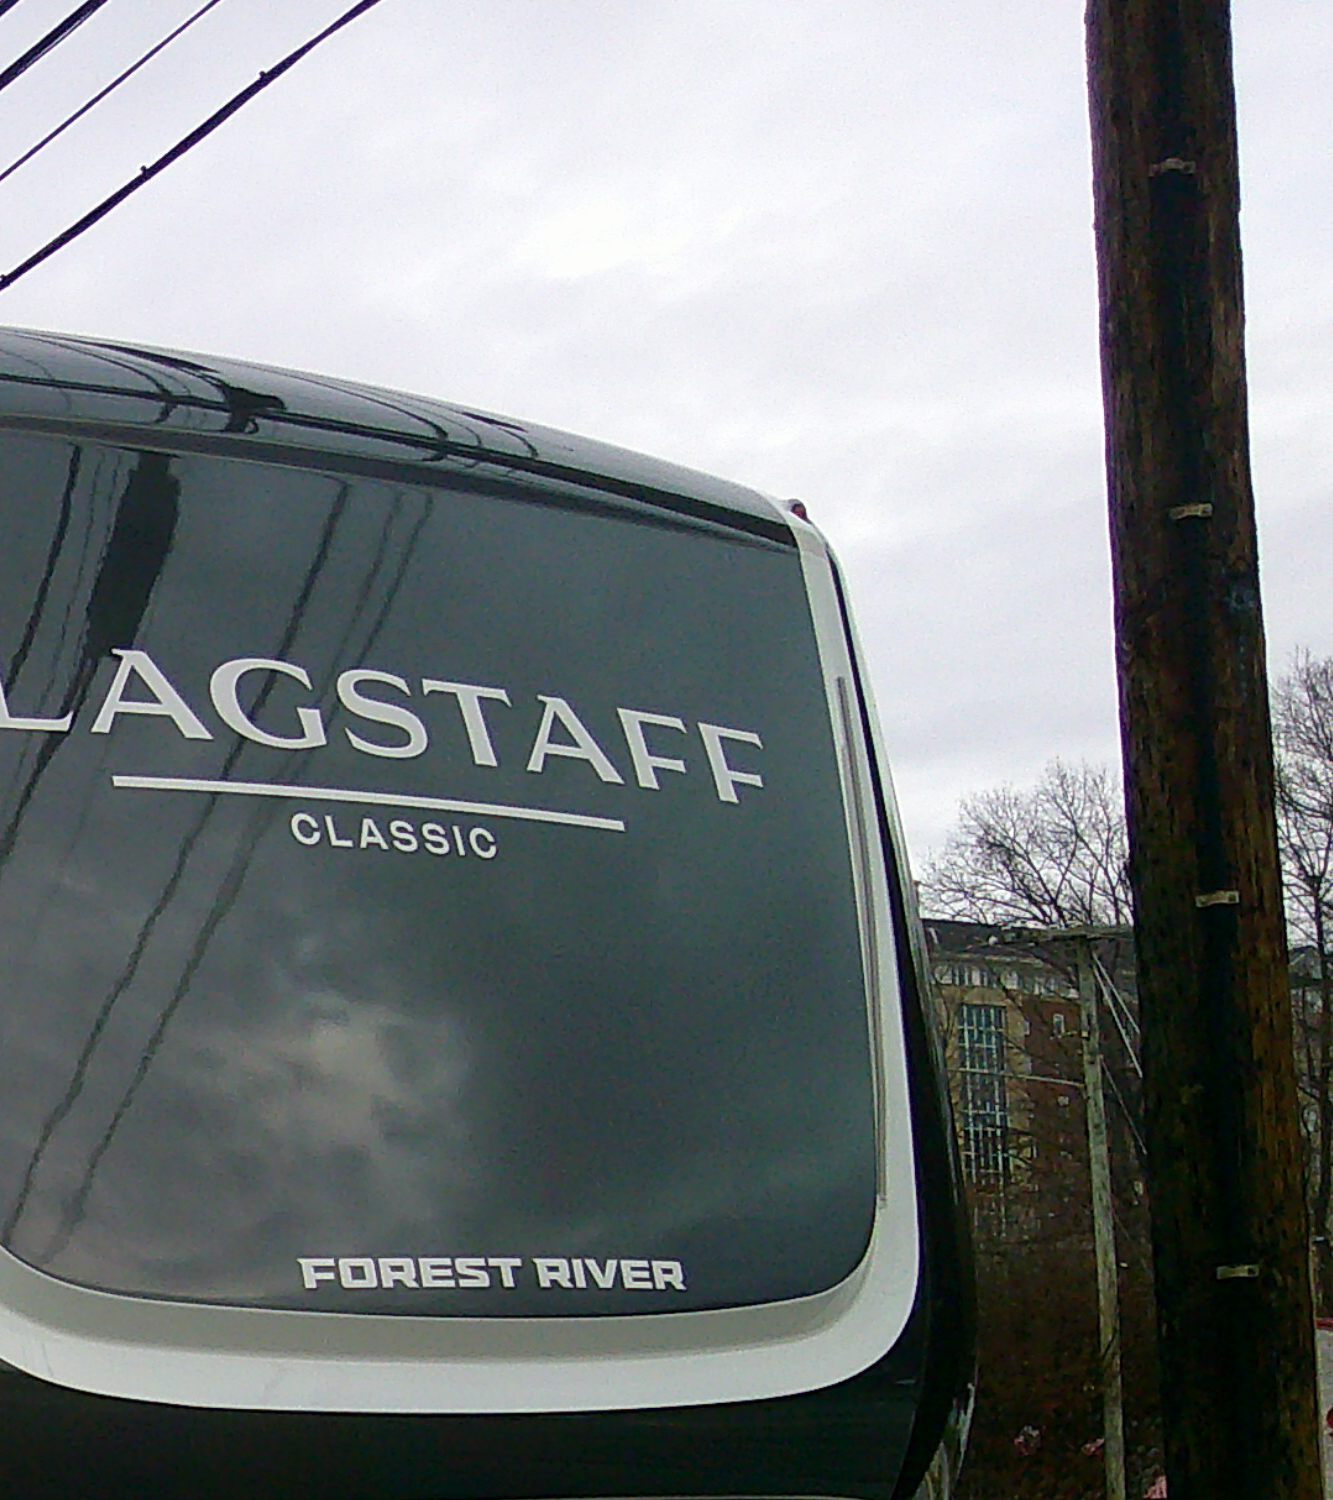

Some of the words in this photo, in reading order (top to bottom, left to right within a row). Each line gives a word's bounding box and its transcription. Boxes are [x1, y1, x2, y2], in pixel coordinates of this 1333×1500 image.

[290, 812, 498, 859] CLASSIC
[296, 1257, 523, 1290] FOREST
[532, 1257, 687, 1292] RIVER
